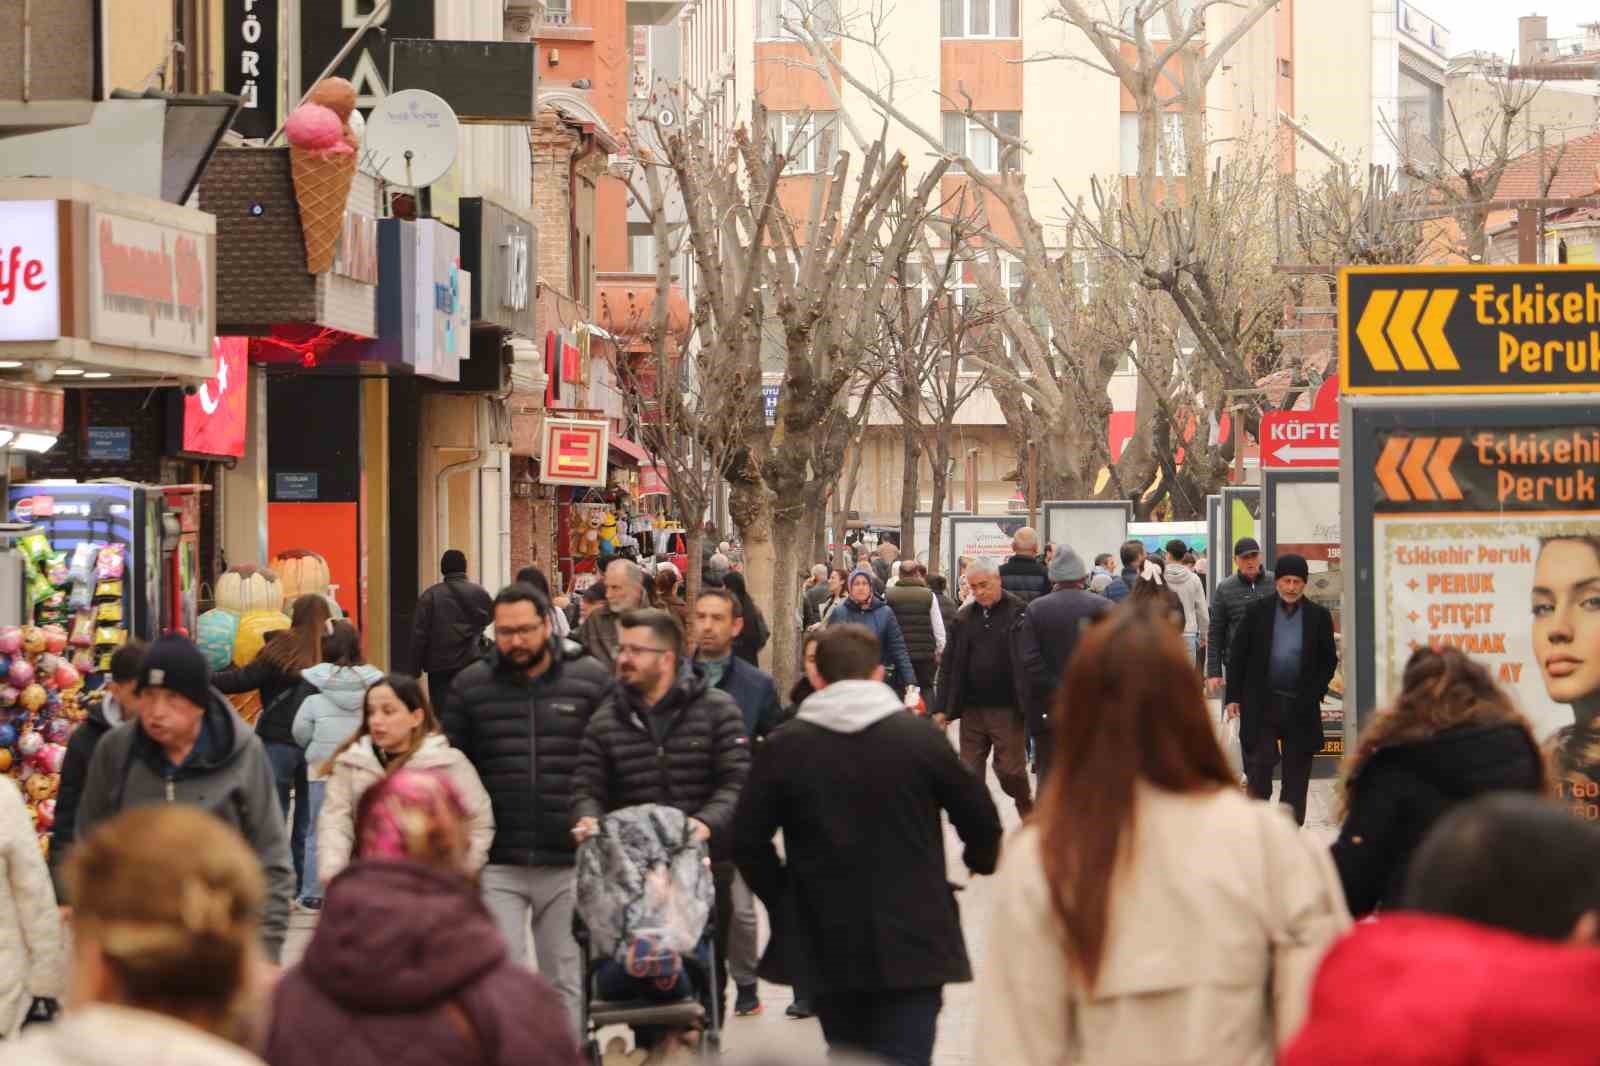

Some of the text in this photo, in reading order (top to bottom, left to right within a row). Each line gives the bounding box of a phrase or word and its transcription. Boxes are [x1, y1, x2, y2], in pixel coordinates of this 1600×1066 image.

[1497, 468, 1595, 502] Peruk
[1476, 543, 1532, 564] Peruk
[1427, 573, 1495, 594] PERUK
